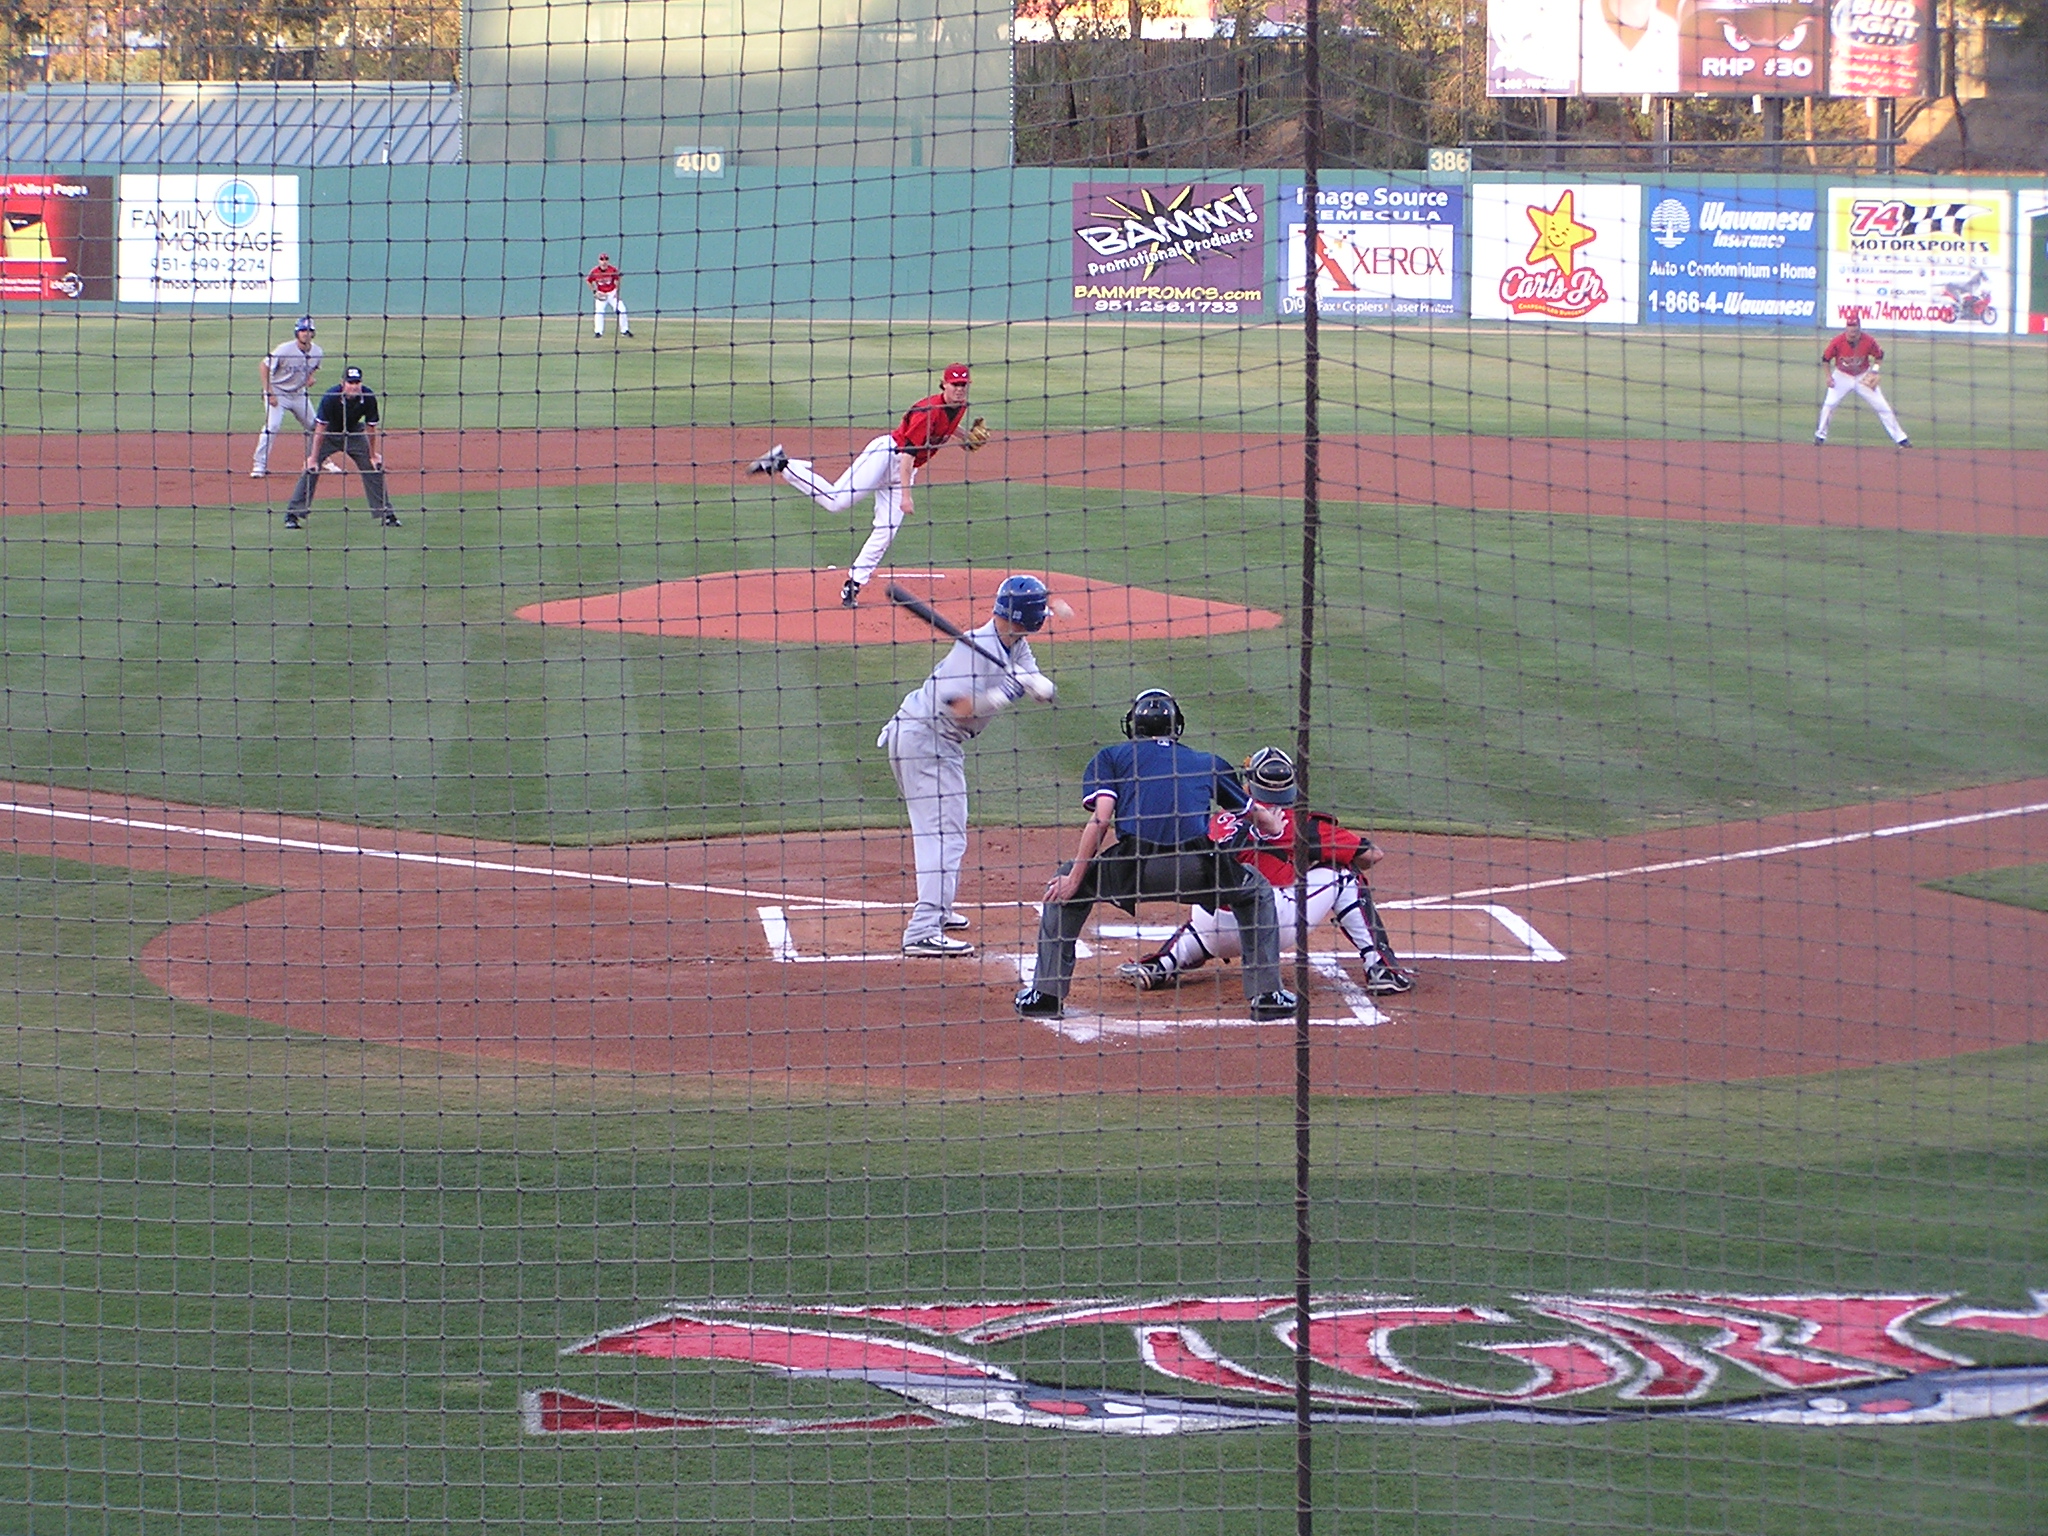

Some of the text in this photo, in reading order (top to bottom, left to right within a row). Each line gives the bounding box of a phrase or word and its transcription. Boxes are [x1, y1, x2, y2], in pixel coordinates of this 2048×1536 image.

[1850, 0, 1916, 19] BUD
[1702, 58, 1755, 77] RHP
[1764, 58, 1813, 77] #30
[676, 152, 722, 172] 400
[1430, 151, 1469, 172] 386
[1374, 187, 1449, 206] Source
[131, 209, 213, 229] FAMILY
[1075, 186, 1259, 256] BAMM!
[1304, 210, 1441, 221] EMECULA
[1699, 201, 1815, 231] Wawanesa
[1853, 203, 1901, 234] 74
[160, 232, 283, 251] MORTGAGE
[1712, 230, 1787, 248] Insurance
[1851, 239, 1989, 252] MOTORSPORTS
[1086, 227, 1254, 277] Promotional Products
[1352, 246, 1445, 275] XEROX
[1649, 260, 1817, 279] Auto Condominium Home
[1074, 285, 1261, 301] BAMMPROMOS.com
[1501, 268, 1606, 301] Carl's Jr.
[1317, 301, 1336, 312] Fax
[1342, 301, 1384, 314] Copiers
[1391, 302, 1419, 313] Laser
[1648, 290, 1816, 316] 1-866-4-Wawanesa
